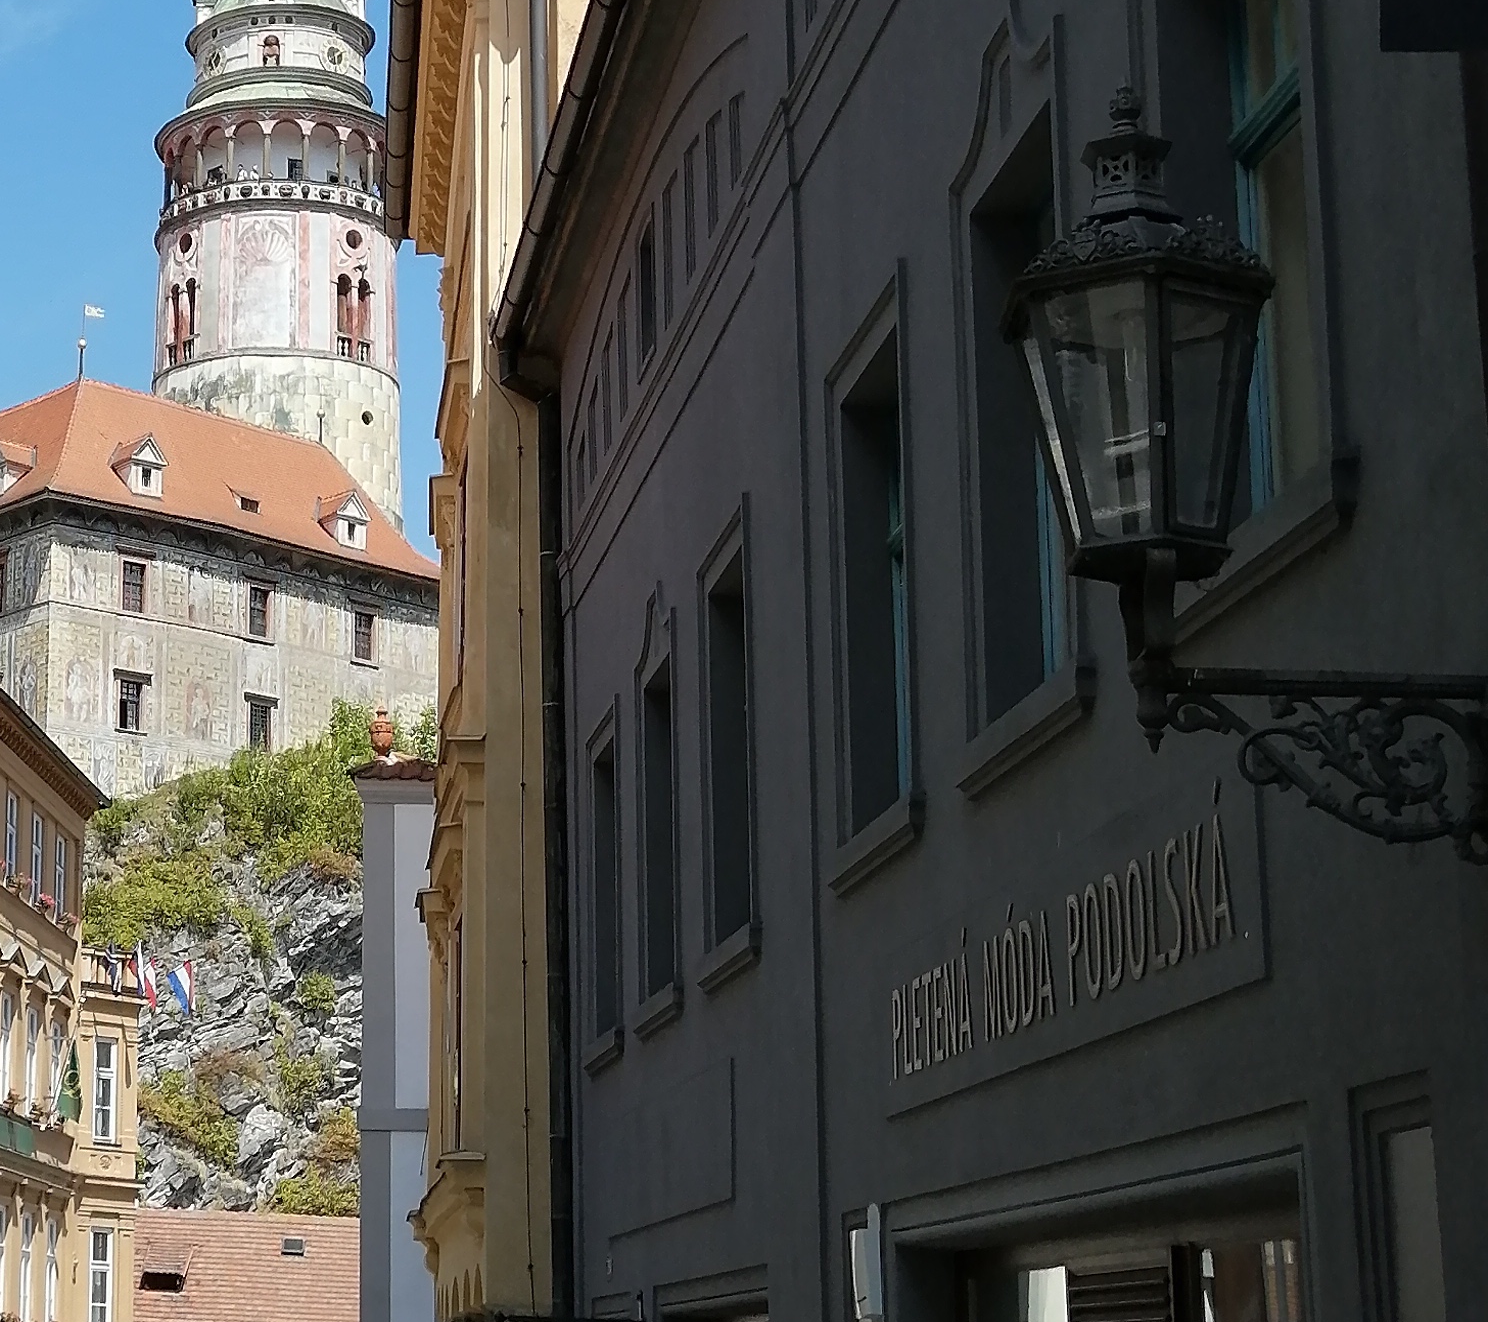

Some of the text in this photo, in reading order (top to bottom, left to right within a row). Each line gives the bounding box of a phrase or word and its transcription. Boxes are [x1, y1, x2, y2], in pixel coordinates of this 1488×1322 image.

[891, 776, 1237, 1080] PLETENÁ MÓDA PODOLSKÁ
